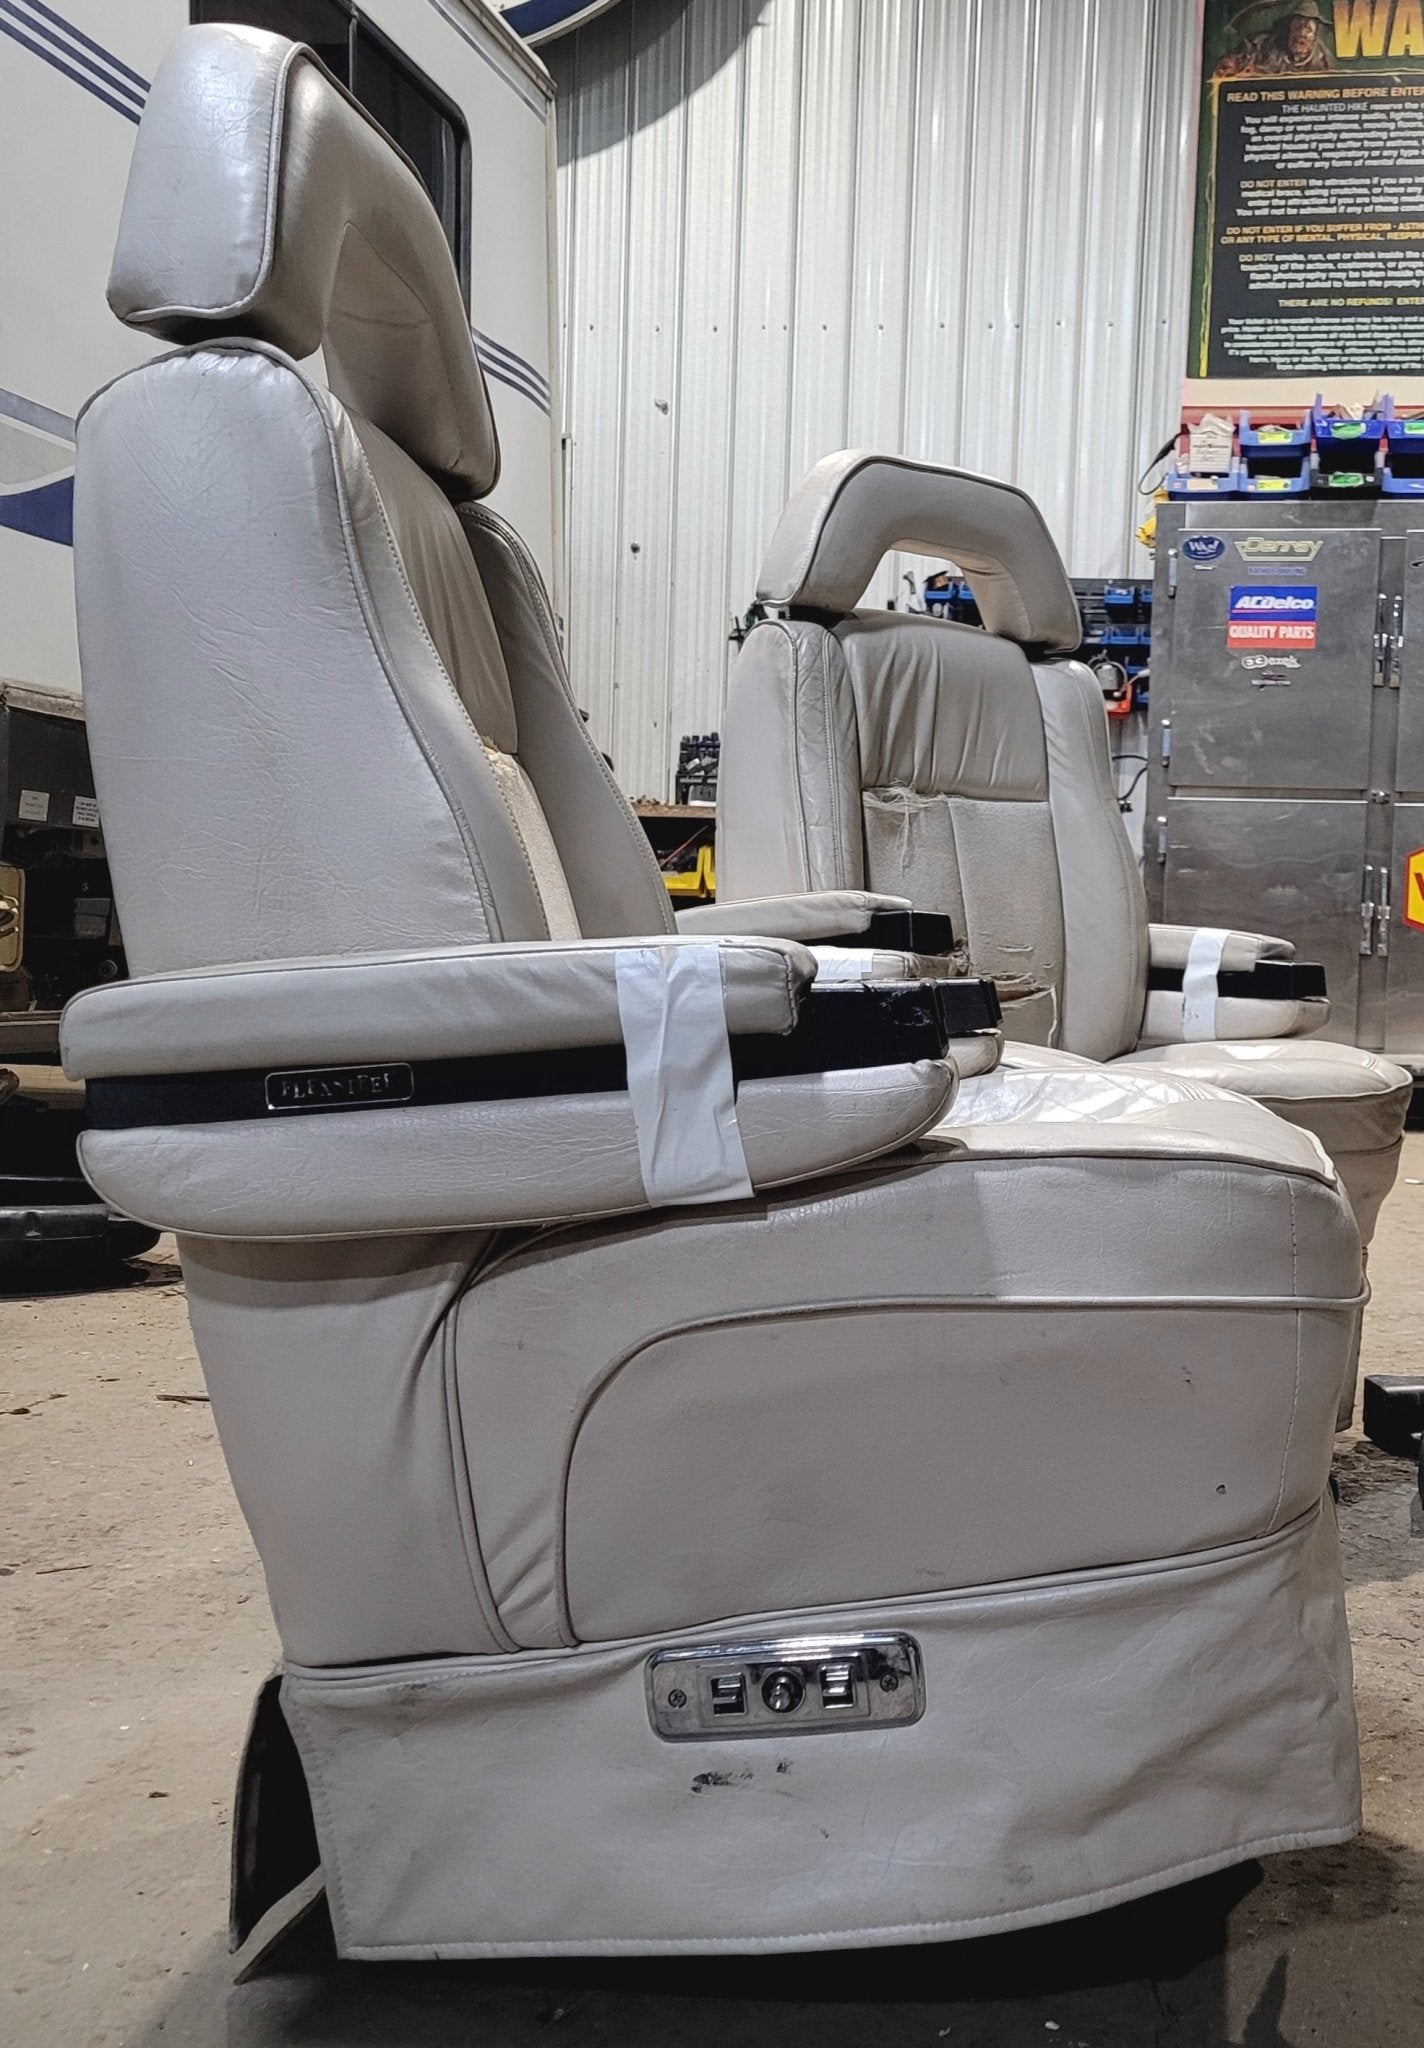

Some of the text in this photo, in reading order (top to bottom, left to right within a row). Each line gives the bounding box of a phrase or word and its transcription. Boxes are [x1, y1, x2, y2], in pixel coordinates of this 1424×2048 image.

[1227, 92, 1259, 102] READ
[1260, 91, 1285, 101] THIS
[1288, 89, 1340, 100] WARNING
[1342, 88, 1389, 98] BEFORE
[1282, 105, 1300, 113] THE
[1301, 103, 1346, 113] HAUNTED
[1347, 102, 1368, 111] HIKE
[1240, 180, 1254, 188] DO
[1255, 180, 1275, 188] NOT
[1277, 179, 1307, 187] ENTER
[1236, 208, 1253, 216] You
[1226, 227, 1240, 235] DO
[1242, 226, 1261, 234] NOT
[1262, 225, 1293, 233] ENTER
[1294, 225, 1304, 233] IF
[1305, 224, 1325, 233] YOU
[1326, 223, 1362, 232] SUFFER
[1364, 223, 1392, 231] FROM
[1220, 236, 1235, 244] OR
[1257, 235, 1281, 243] TYPE
[1281, 234, 1295, 243] OF
[1239, 254, 1253, 262] DO
[1278, 299, 1310, 307] THERE
[1310, 298, 1330, 307] ARE
[1331, 298, 1345, 306] NO
[1235, 596, 1315, 610] ACDelco
[1229, 625, 1315, 639] QUALITY PARTS
